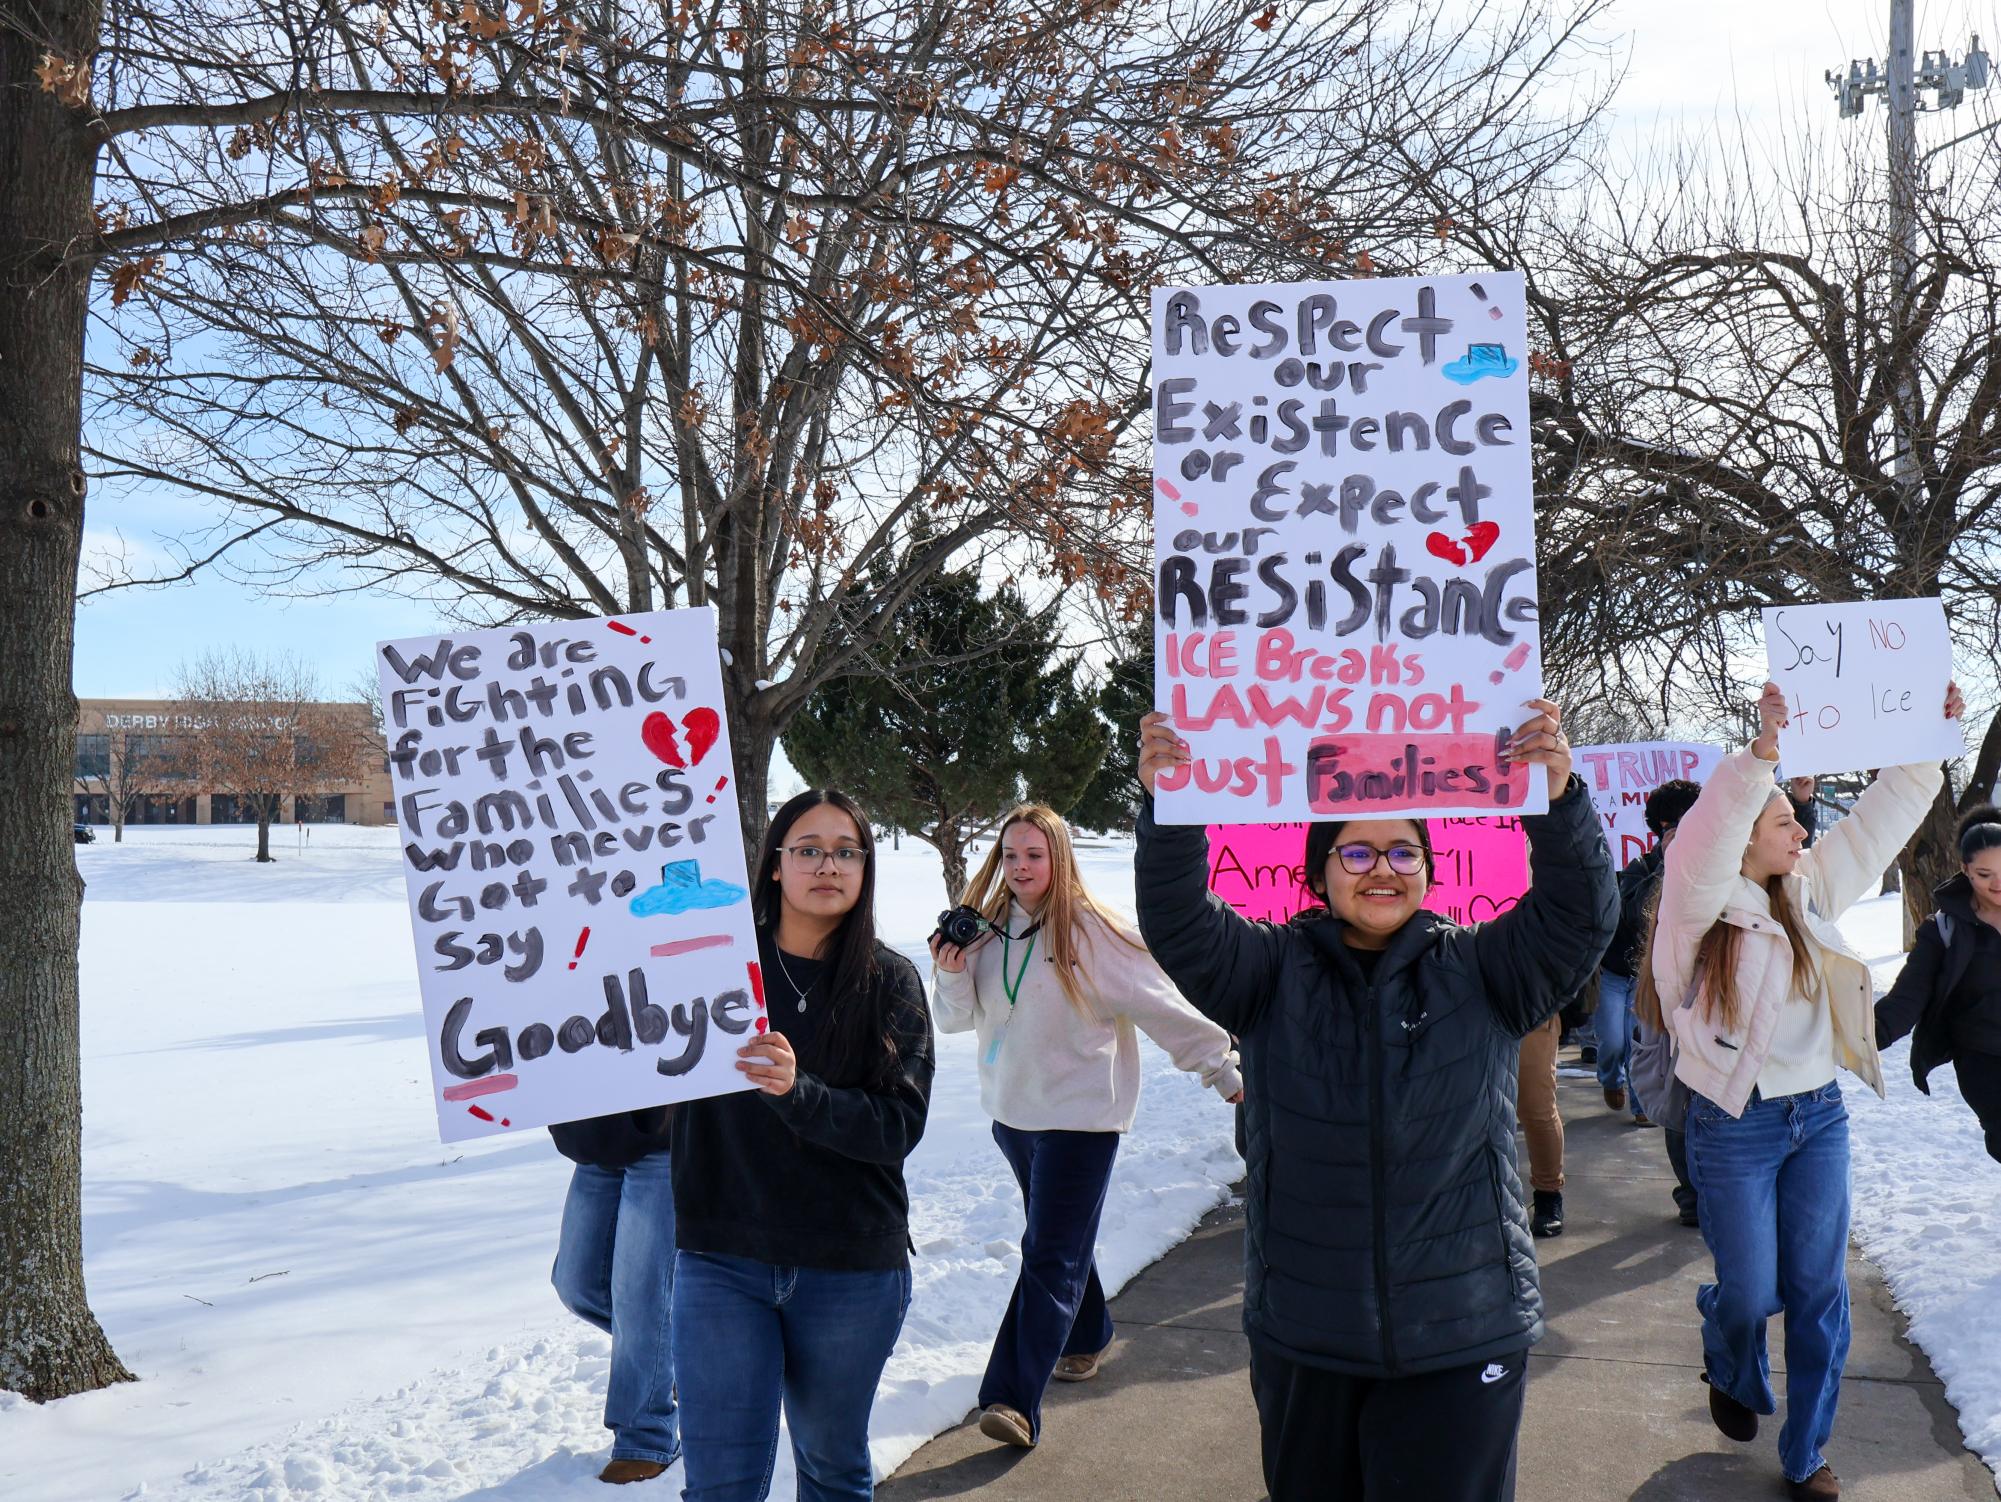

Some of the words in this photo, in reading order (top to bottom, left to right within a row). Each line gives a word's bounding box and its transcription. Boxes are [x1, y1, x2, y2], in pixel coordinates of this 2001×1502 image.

[1273, 357, 1385, 395] our
[1180, 448, 1245, 483] or
[1172, 527, 1281, 556] our
[382, 639, 483, 684] We
[506, 631, 598, 672] are
[1165, 630, 1241, 679] ICE
[1776, 611, 1842, 678] Say
[1868, 618, 1906, 650] NO
[106, 714, 170, 729] DERBY
[1171, 682, 1355, 733] LAWS
[1366, 683, 1486, 735] not
[1793, 693, 1841, 735] to
[389, 728, 469, 781] for
[476, 725, 597, 781] the
[1155, 735, 1297, 808] Just
[1582, 750, 1699, 791] TRUMP
[550, 814, 717, 866] never
[418, 869, 548, 922] Got
[568, 867, 637, 906] to
[1486, 1363, 1504, 1377] NIKE
